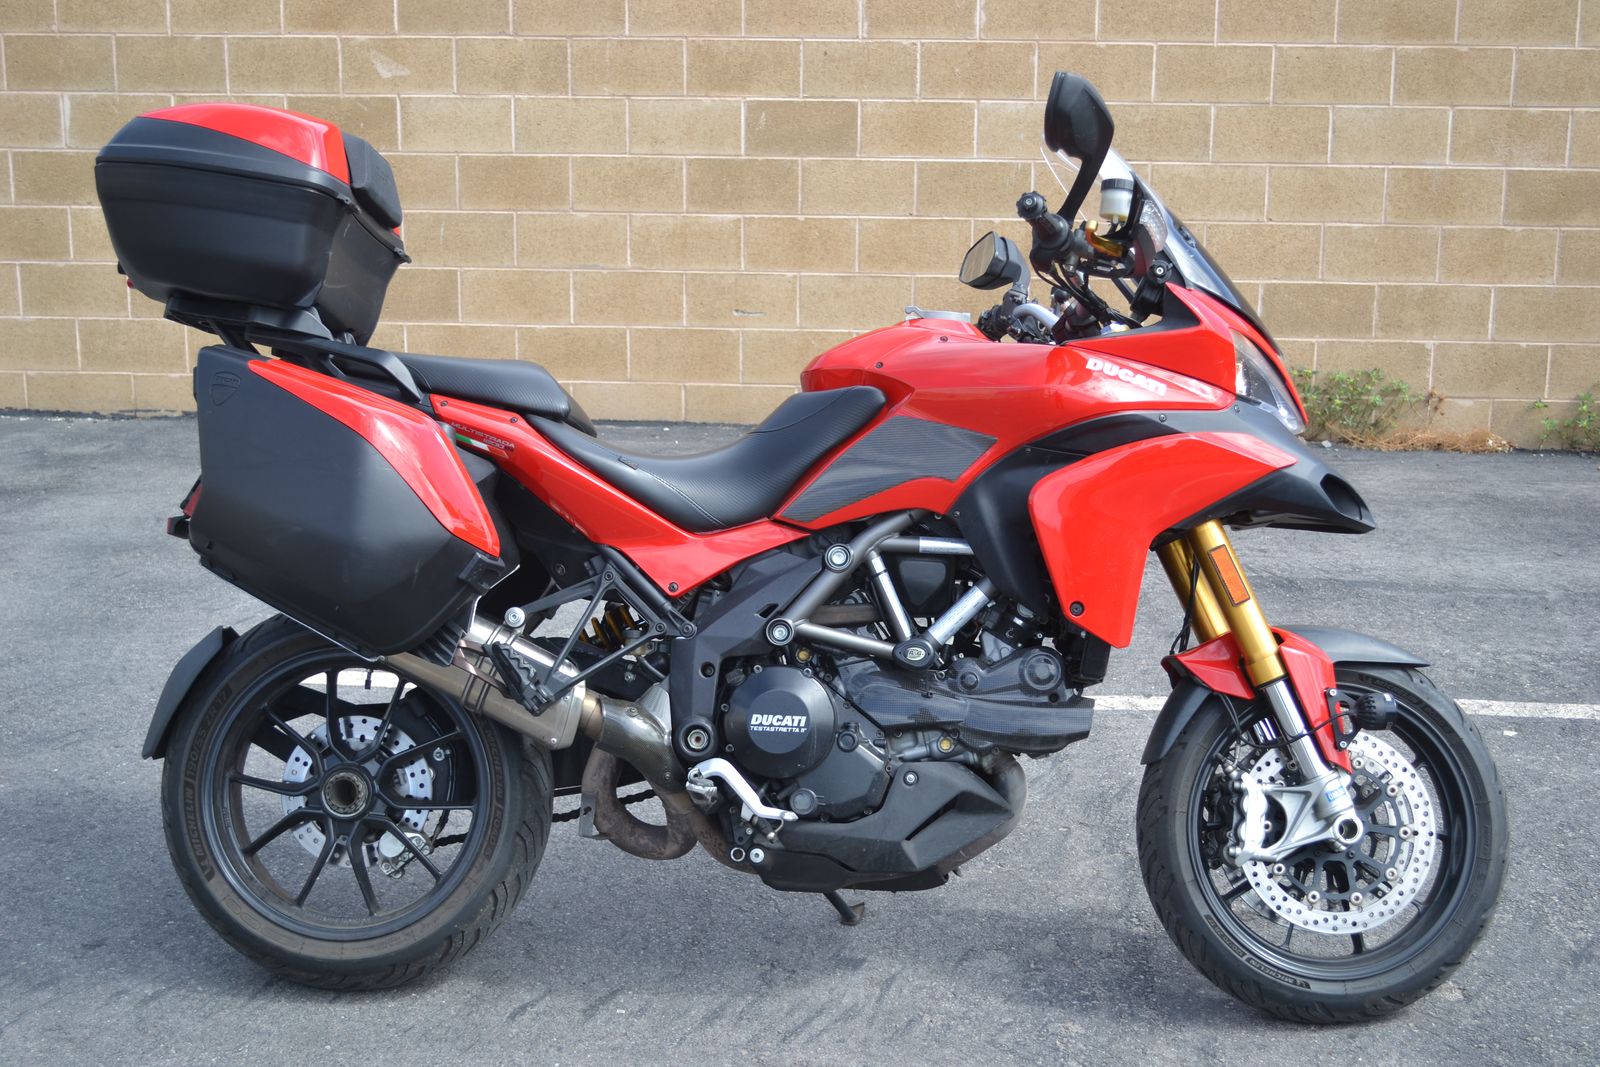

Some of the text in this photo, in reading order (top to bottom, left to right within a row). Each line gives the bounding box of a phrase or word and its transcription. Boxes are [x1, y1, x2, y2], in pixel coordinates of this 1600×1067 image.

[1085, 357, 1167, 396] DUCATI
[450, 421, 515, 448] MULTISTRADA
[750, 713, 807, 727] DUCATI
[486, 730, 504, 799] MICHELIN
[184, 788, 206, 857] MICHELIN
[490, 811, 503, 846] ROAD
[1249, 958, 1294, 985] MICHELIN
